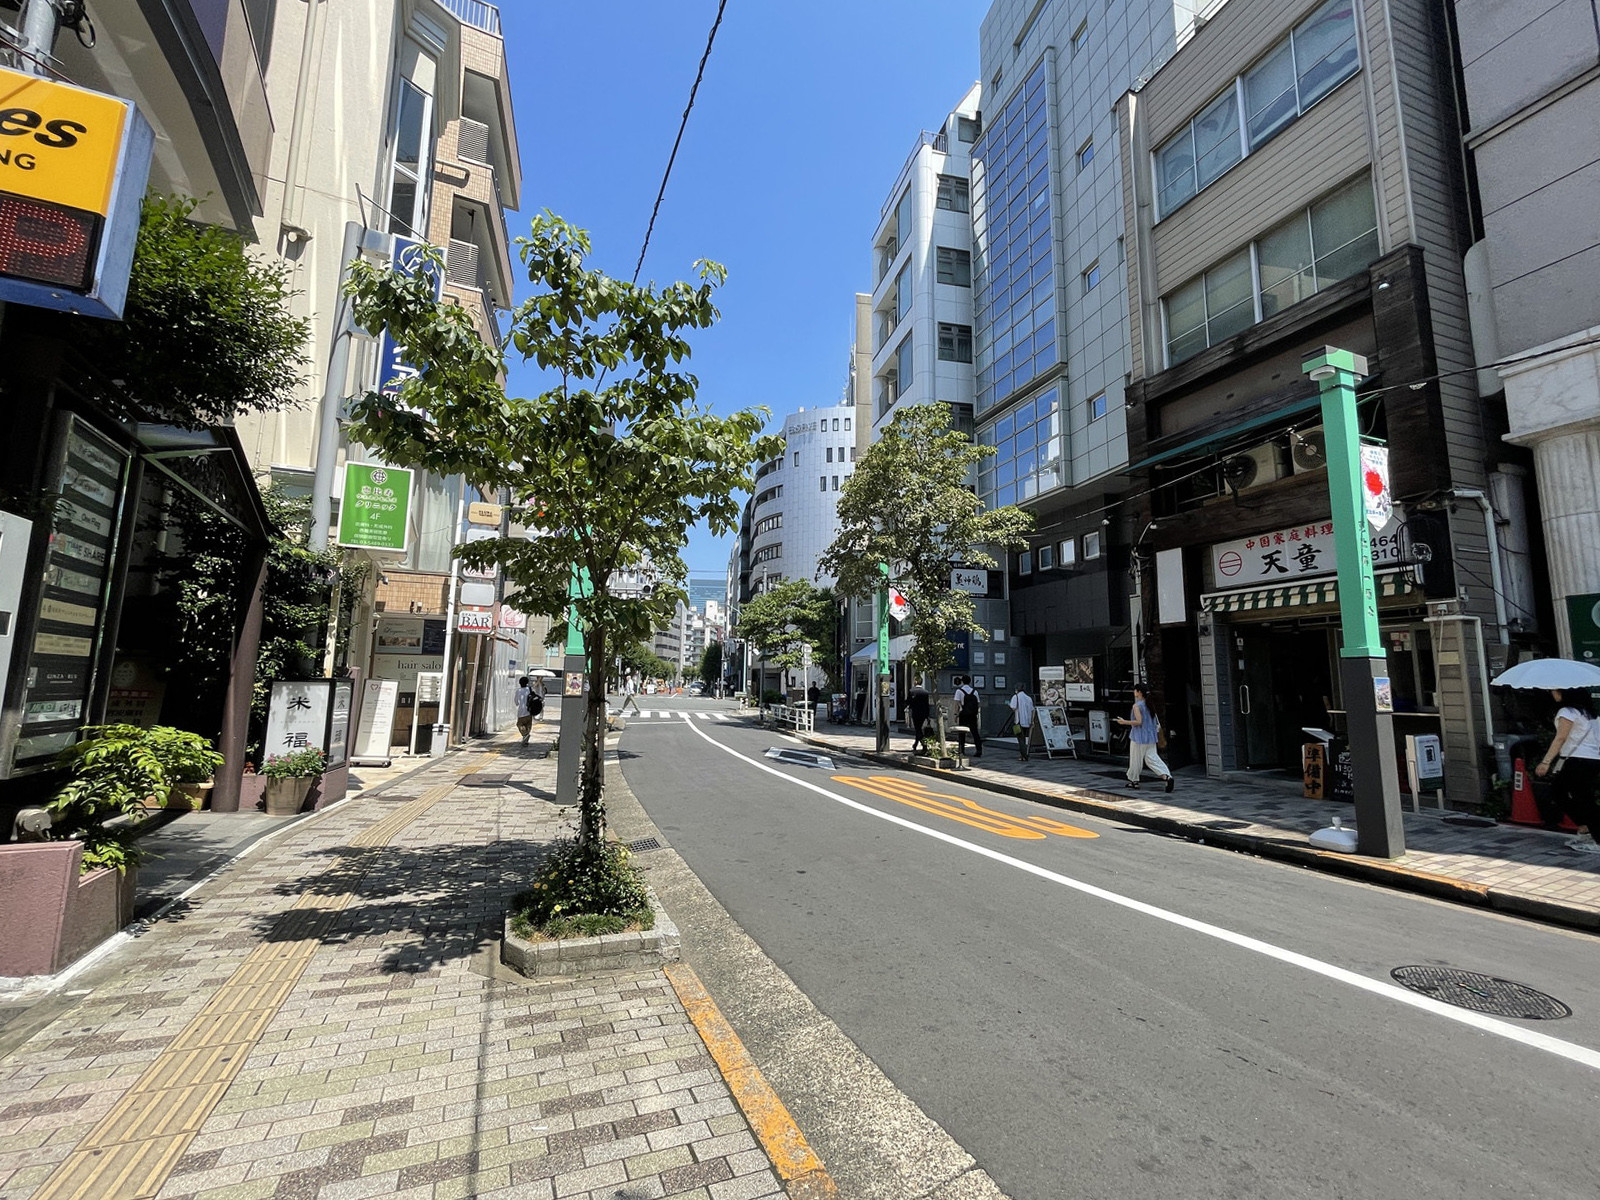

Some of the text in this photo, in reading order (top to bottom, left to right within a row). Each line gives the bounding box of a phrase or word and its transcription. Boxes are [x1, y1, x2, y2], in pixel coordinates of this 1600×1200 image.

[355, 500, 397, 511] クリニック
[1245, 523, 1333, 551] 中国家庭料理
[1260, 543, 1322, 574] 天童
[461, 616, 489, 628] BAR
[398, 660, 444, 671] hair salo
[283, 696, 312, 748] 米福
[1304, 747, 1322, 794] 準備中
